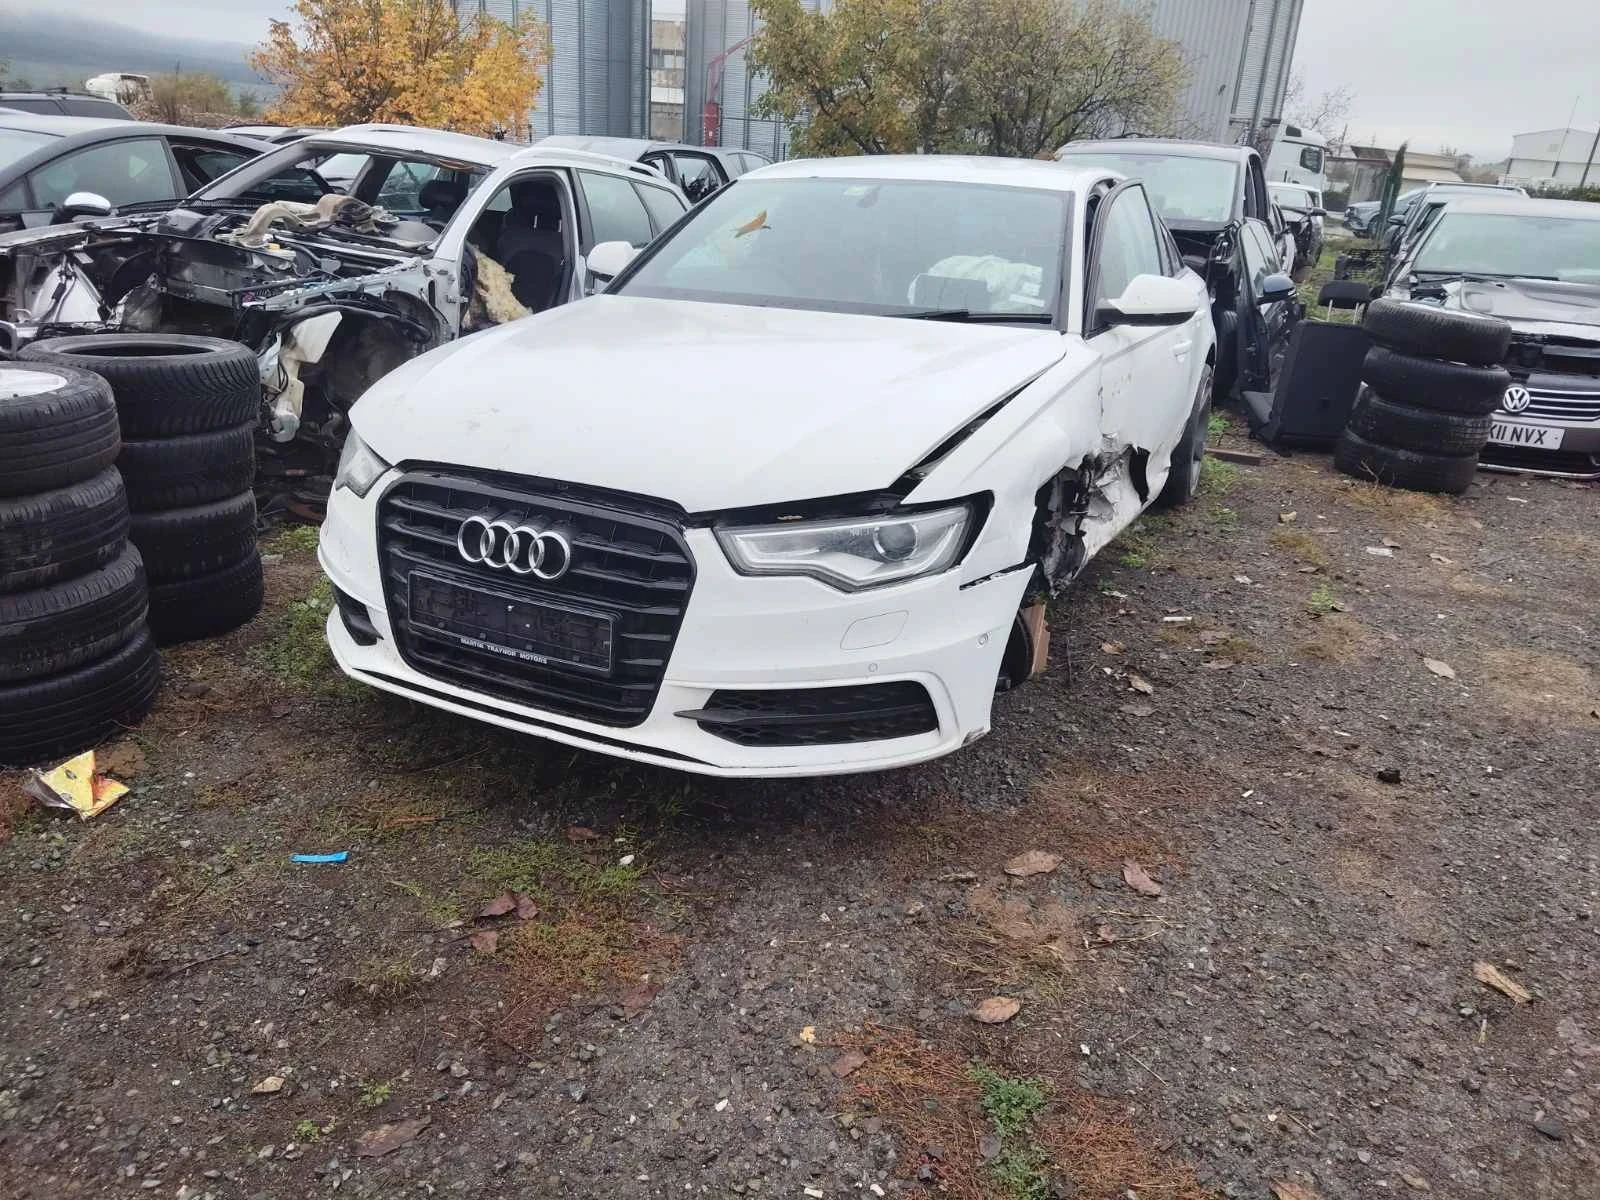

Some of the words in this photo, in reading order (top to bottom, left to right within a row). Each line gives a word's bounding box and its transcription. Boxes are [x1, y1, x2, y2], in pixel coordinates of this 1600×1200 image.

[1504, 387, 1530, 411] VW
[1510, 426, 1548, 445] NVX
[487, 644, 517, 657] TRAYNOR
[519, 652, 548, 665] MOTORS
